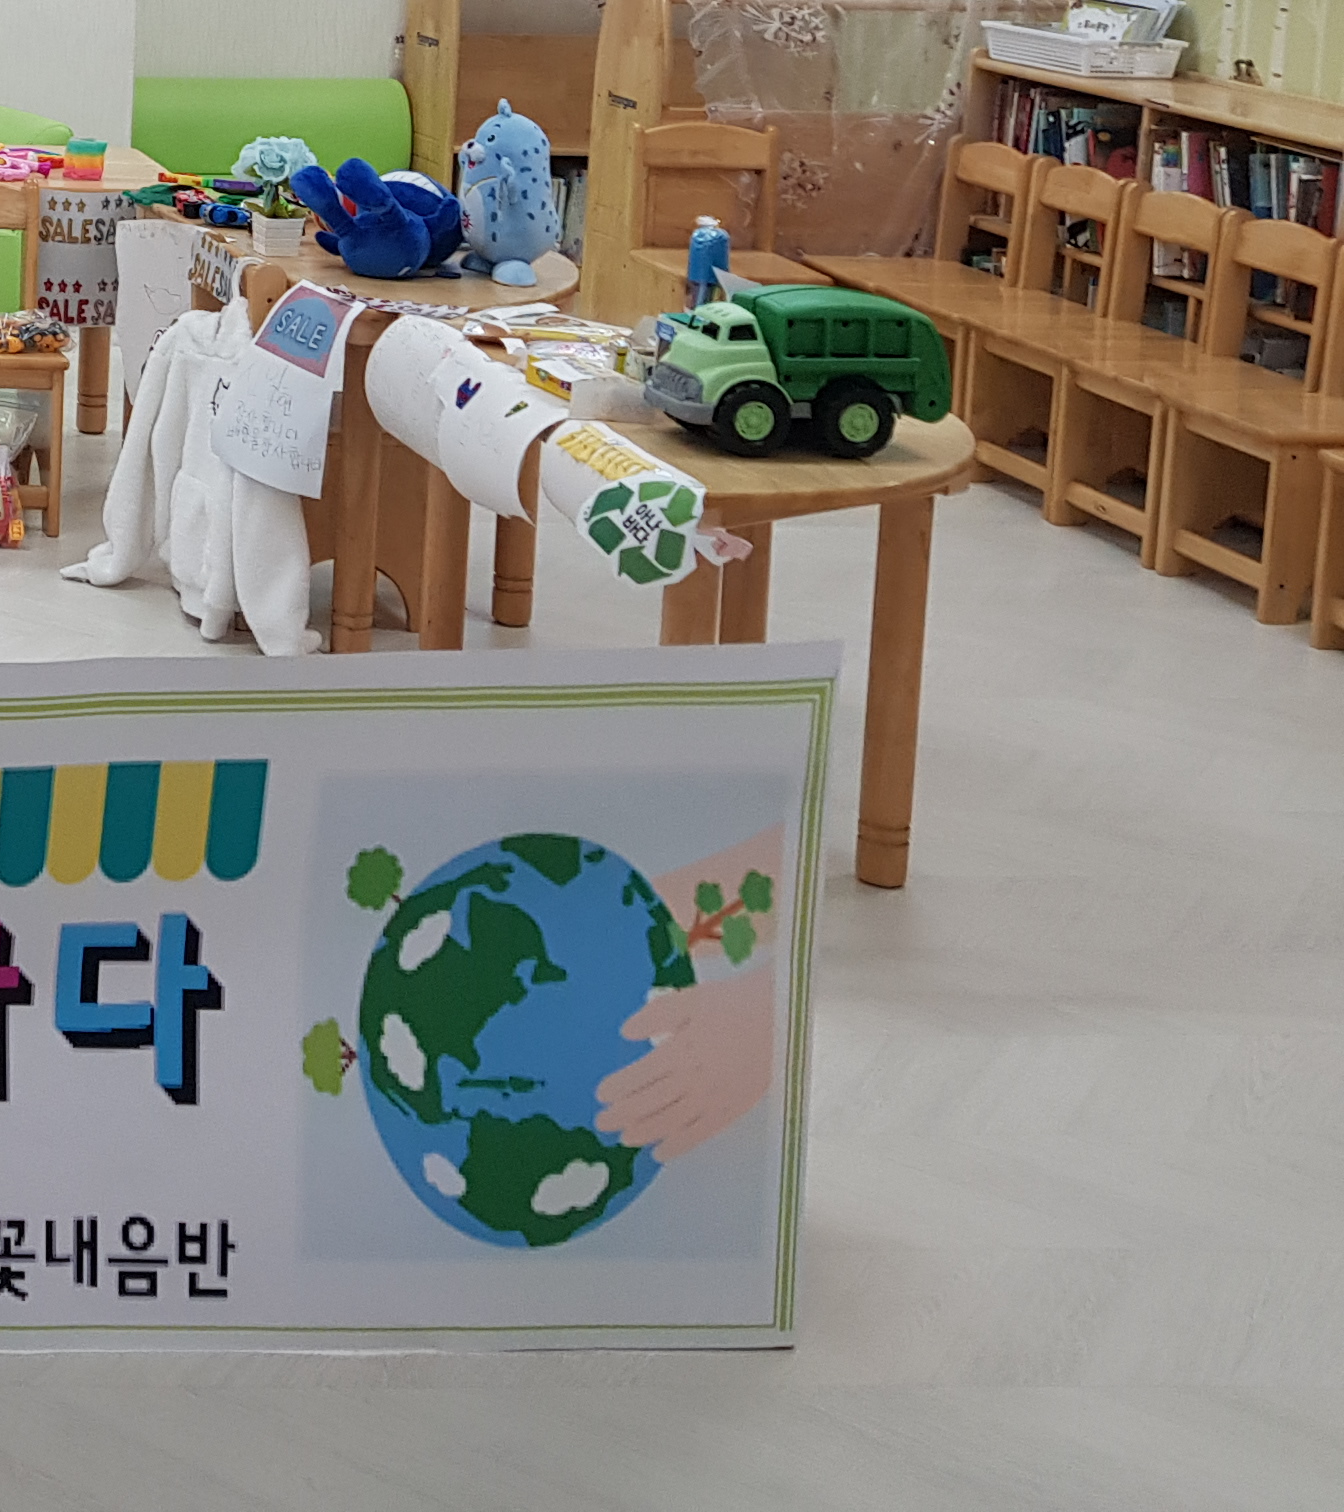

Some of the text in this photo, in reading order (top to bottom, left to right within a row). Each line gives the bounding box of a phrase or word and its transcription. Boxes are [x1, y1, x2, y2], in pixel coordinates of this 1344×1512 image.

[38, 215, 93, 244] SALE
[188, 252, 220, 291] SALE
[275, 306, 328, 351] SALE
[623, 515, 648, 544] 바다
[636, 504, 662, 531] 아나
